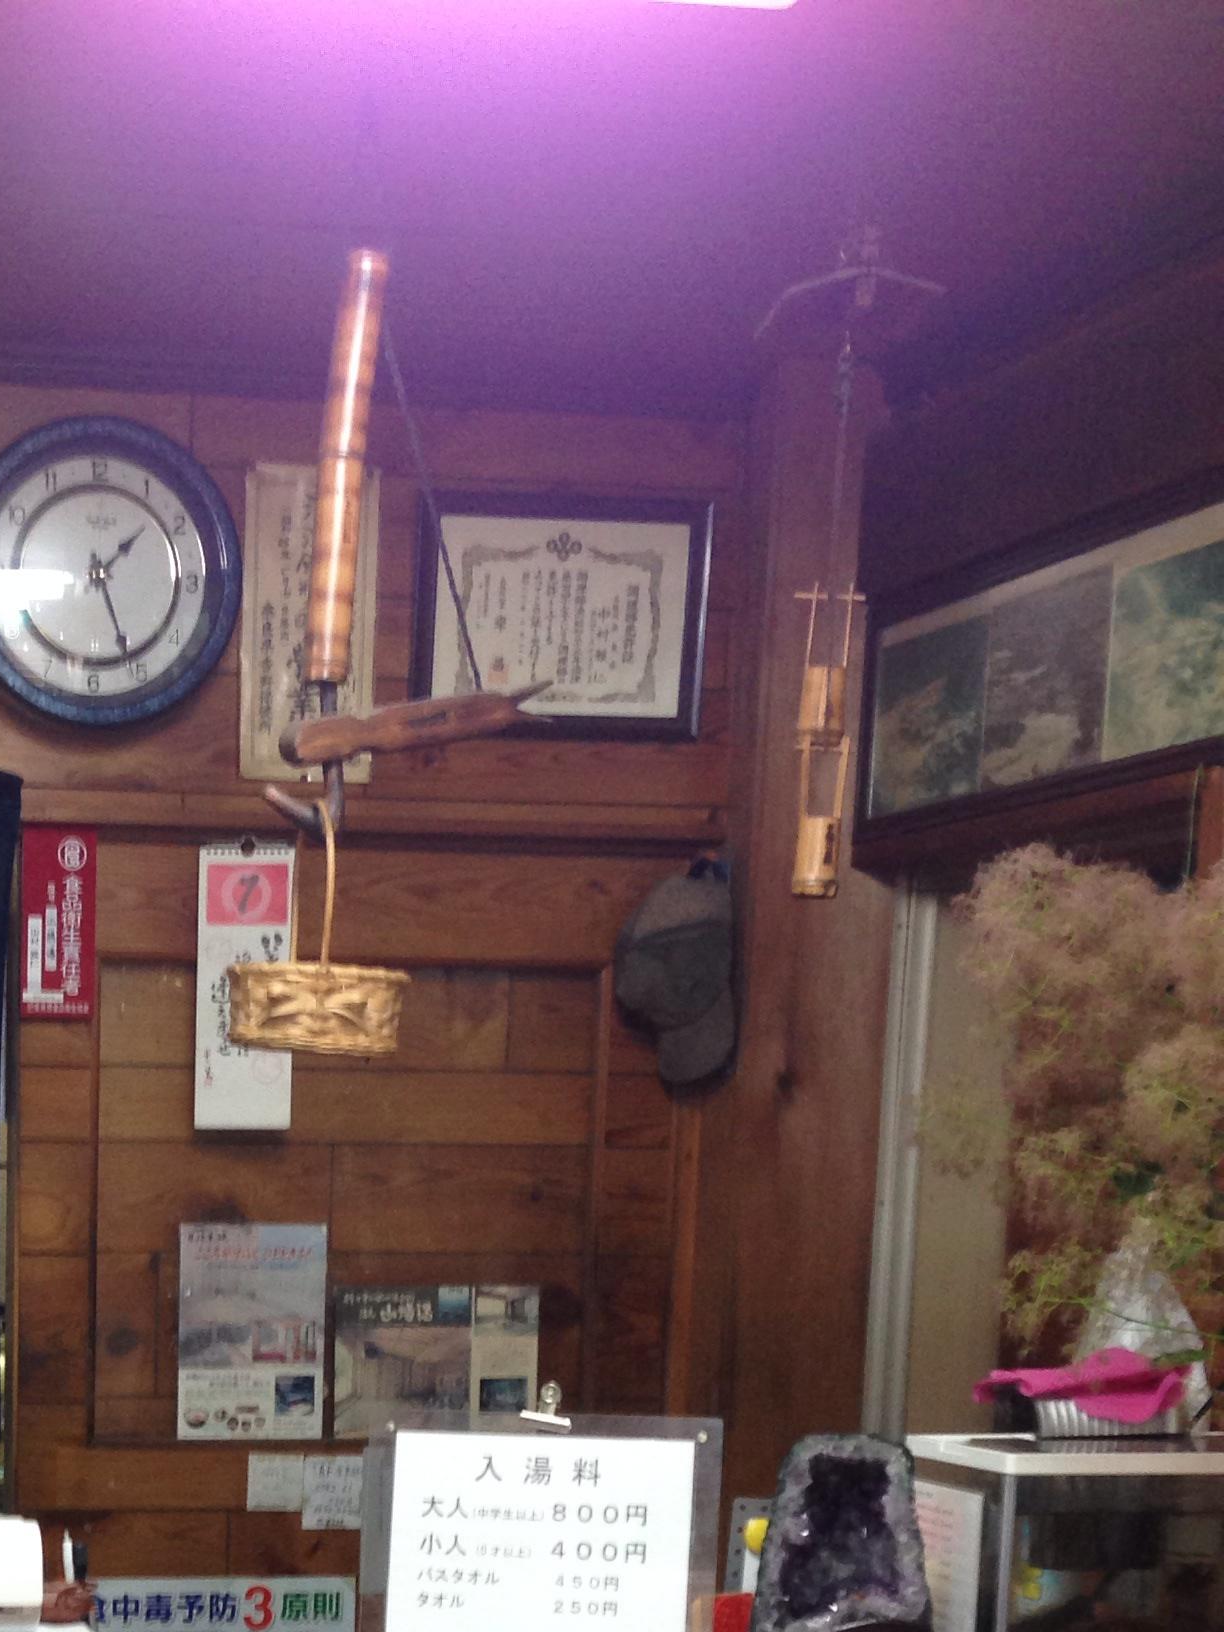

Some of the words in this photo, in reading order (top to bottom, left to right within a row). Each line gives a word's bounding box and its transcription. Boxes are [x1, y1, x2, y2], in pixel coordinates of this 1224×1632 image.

[173, 517, 186, 535] 2
[186, 575, 199, 593] 3
[88, 674, 99, 693] 6
[475, 1455, 601, 1487] 入湯料
[552, 1503, 648, 1527] 800円
[551, 1541, 647, 1564] 400円
[417, 1592, 464, 1608] タオル
[554, 1601, 618, 1617] 250円
